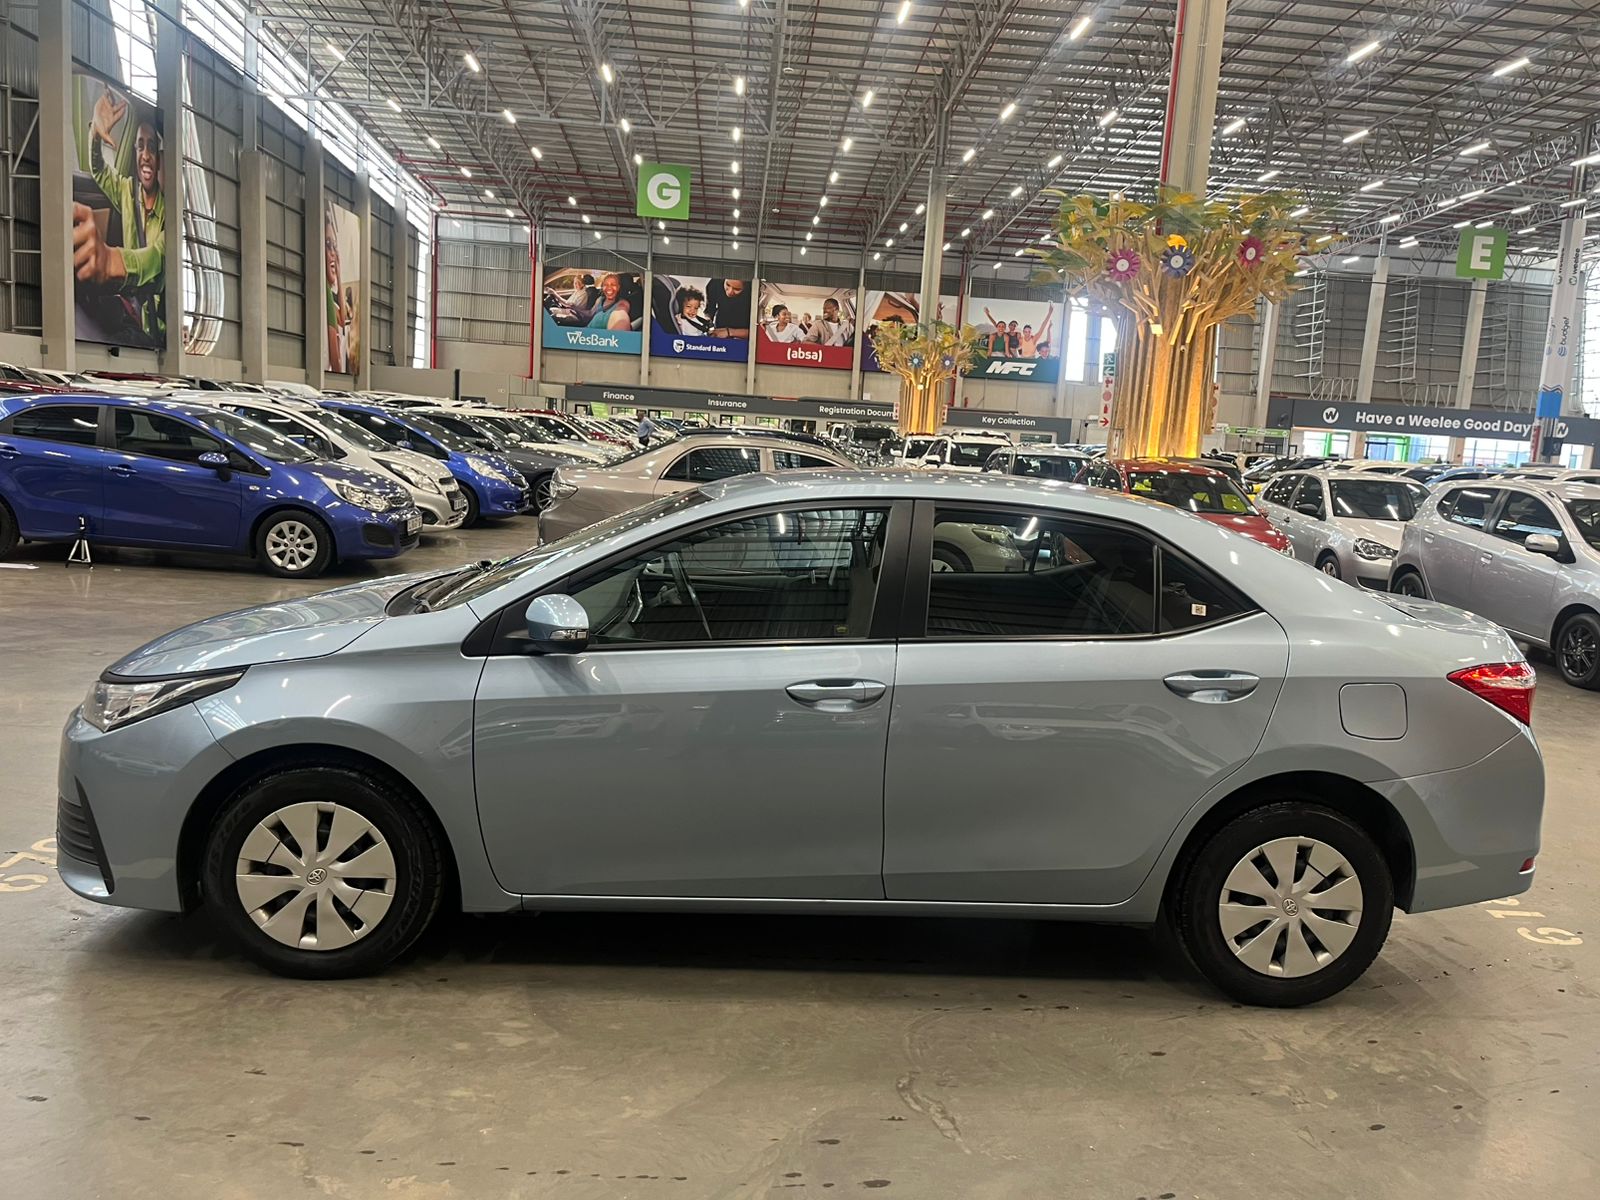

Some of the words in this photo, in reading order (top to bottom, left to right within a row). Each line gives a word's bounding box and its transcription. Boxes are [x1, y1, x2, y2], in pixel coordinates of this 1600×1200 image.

[647, 173, 680, 209] G
[1470, 235, 1494, 270] E
[566, 331, 619, 347] WesBank
[686, 344, 711, 352] Standard
[787, 347, 822, 362] (absa)
[986, 361, 1037, 376] MFC
[603, 391, 635, 401] Finance
[708, 398, 748, 408] Insurance
[819, 405, 866, 415] Registration
[982, 416, 997, 425] Key
[997, 417, 1036, 426] Collection
[1356, 411, 1393, 425] Have
[1396, 416, 1405, 425] a
[1409, 415, 1461, 429] Weelee
[1463, 418, 1501, 431] Good
[1503, 421, 1532, 437] Day
